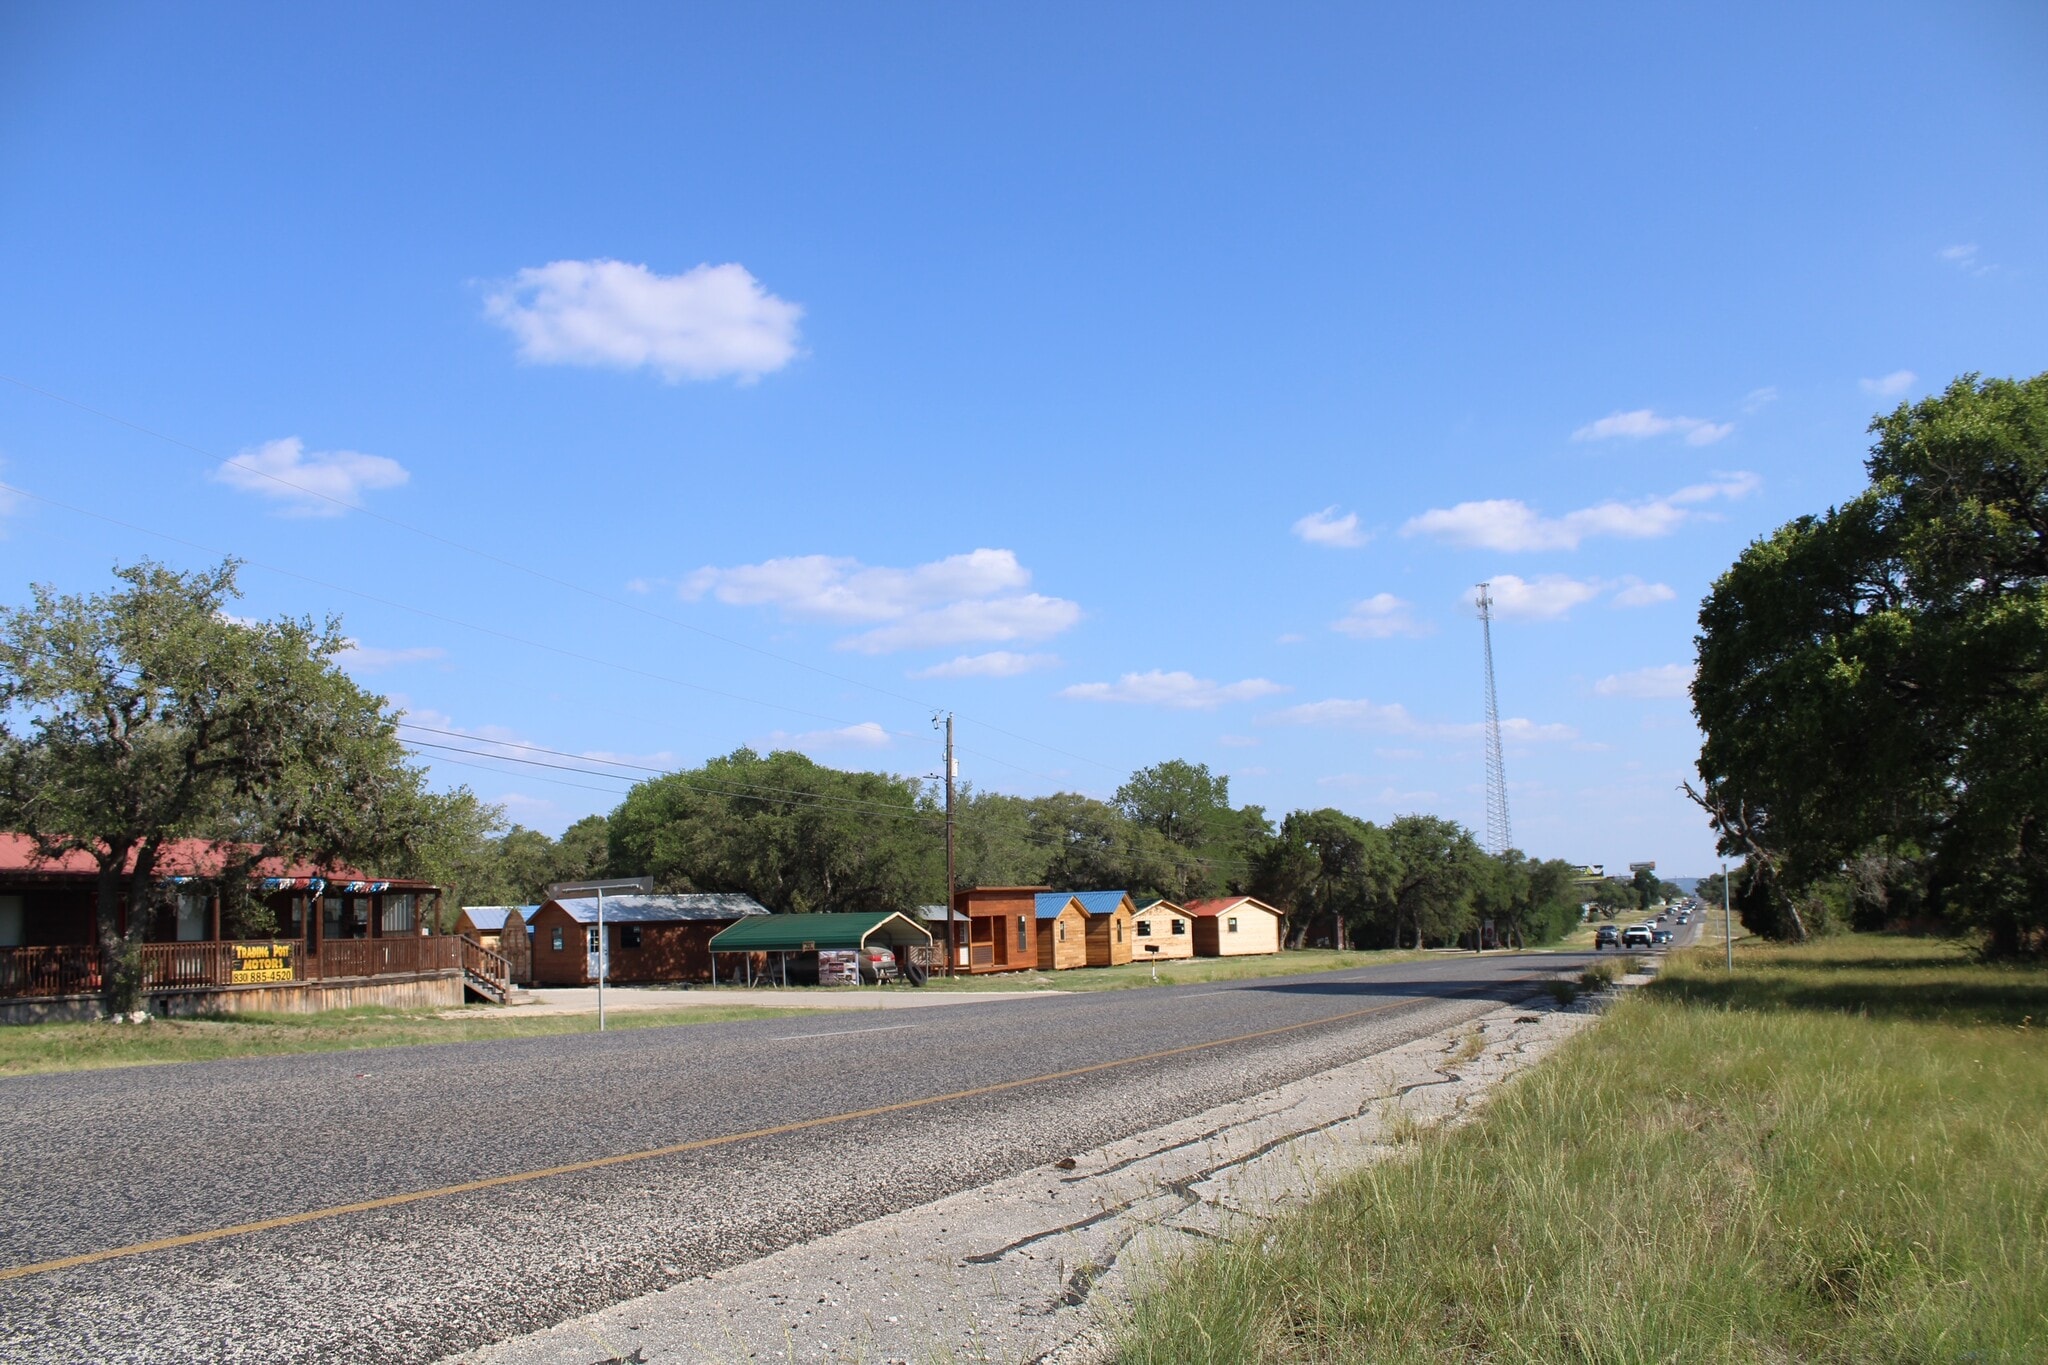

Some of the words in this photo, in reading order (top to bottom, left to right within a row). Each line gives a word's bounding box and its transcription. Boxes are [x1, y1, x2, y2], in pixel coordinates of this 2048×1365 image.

[242, 958, 283, 970] MOTORS
[234, 973, 247, 982] 830
[250, 970, 291, 982] 885-4520
